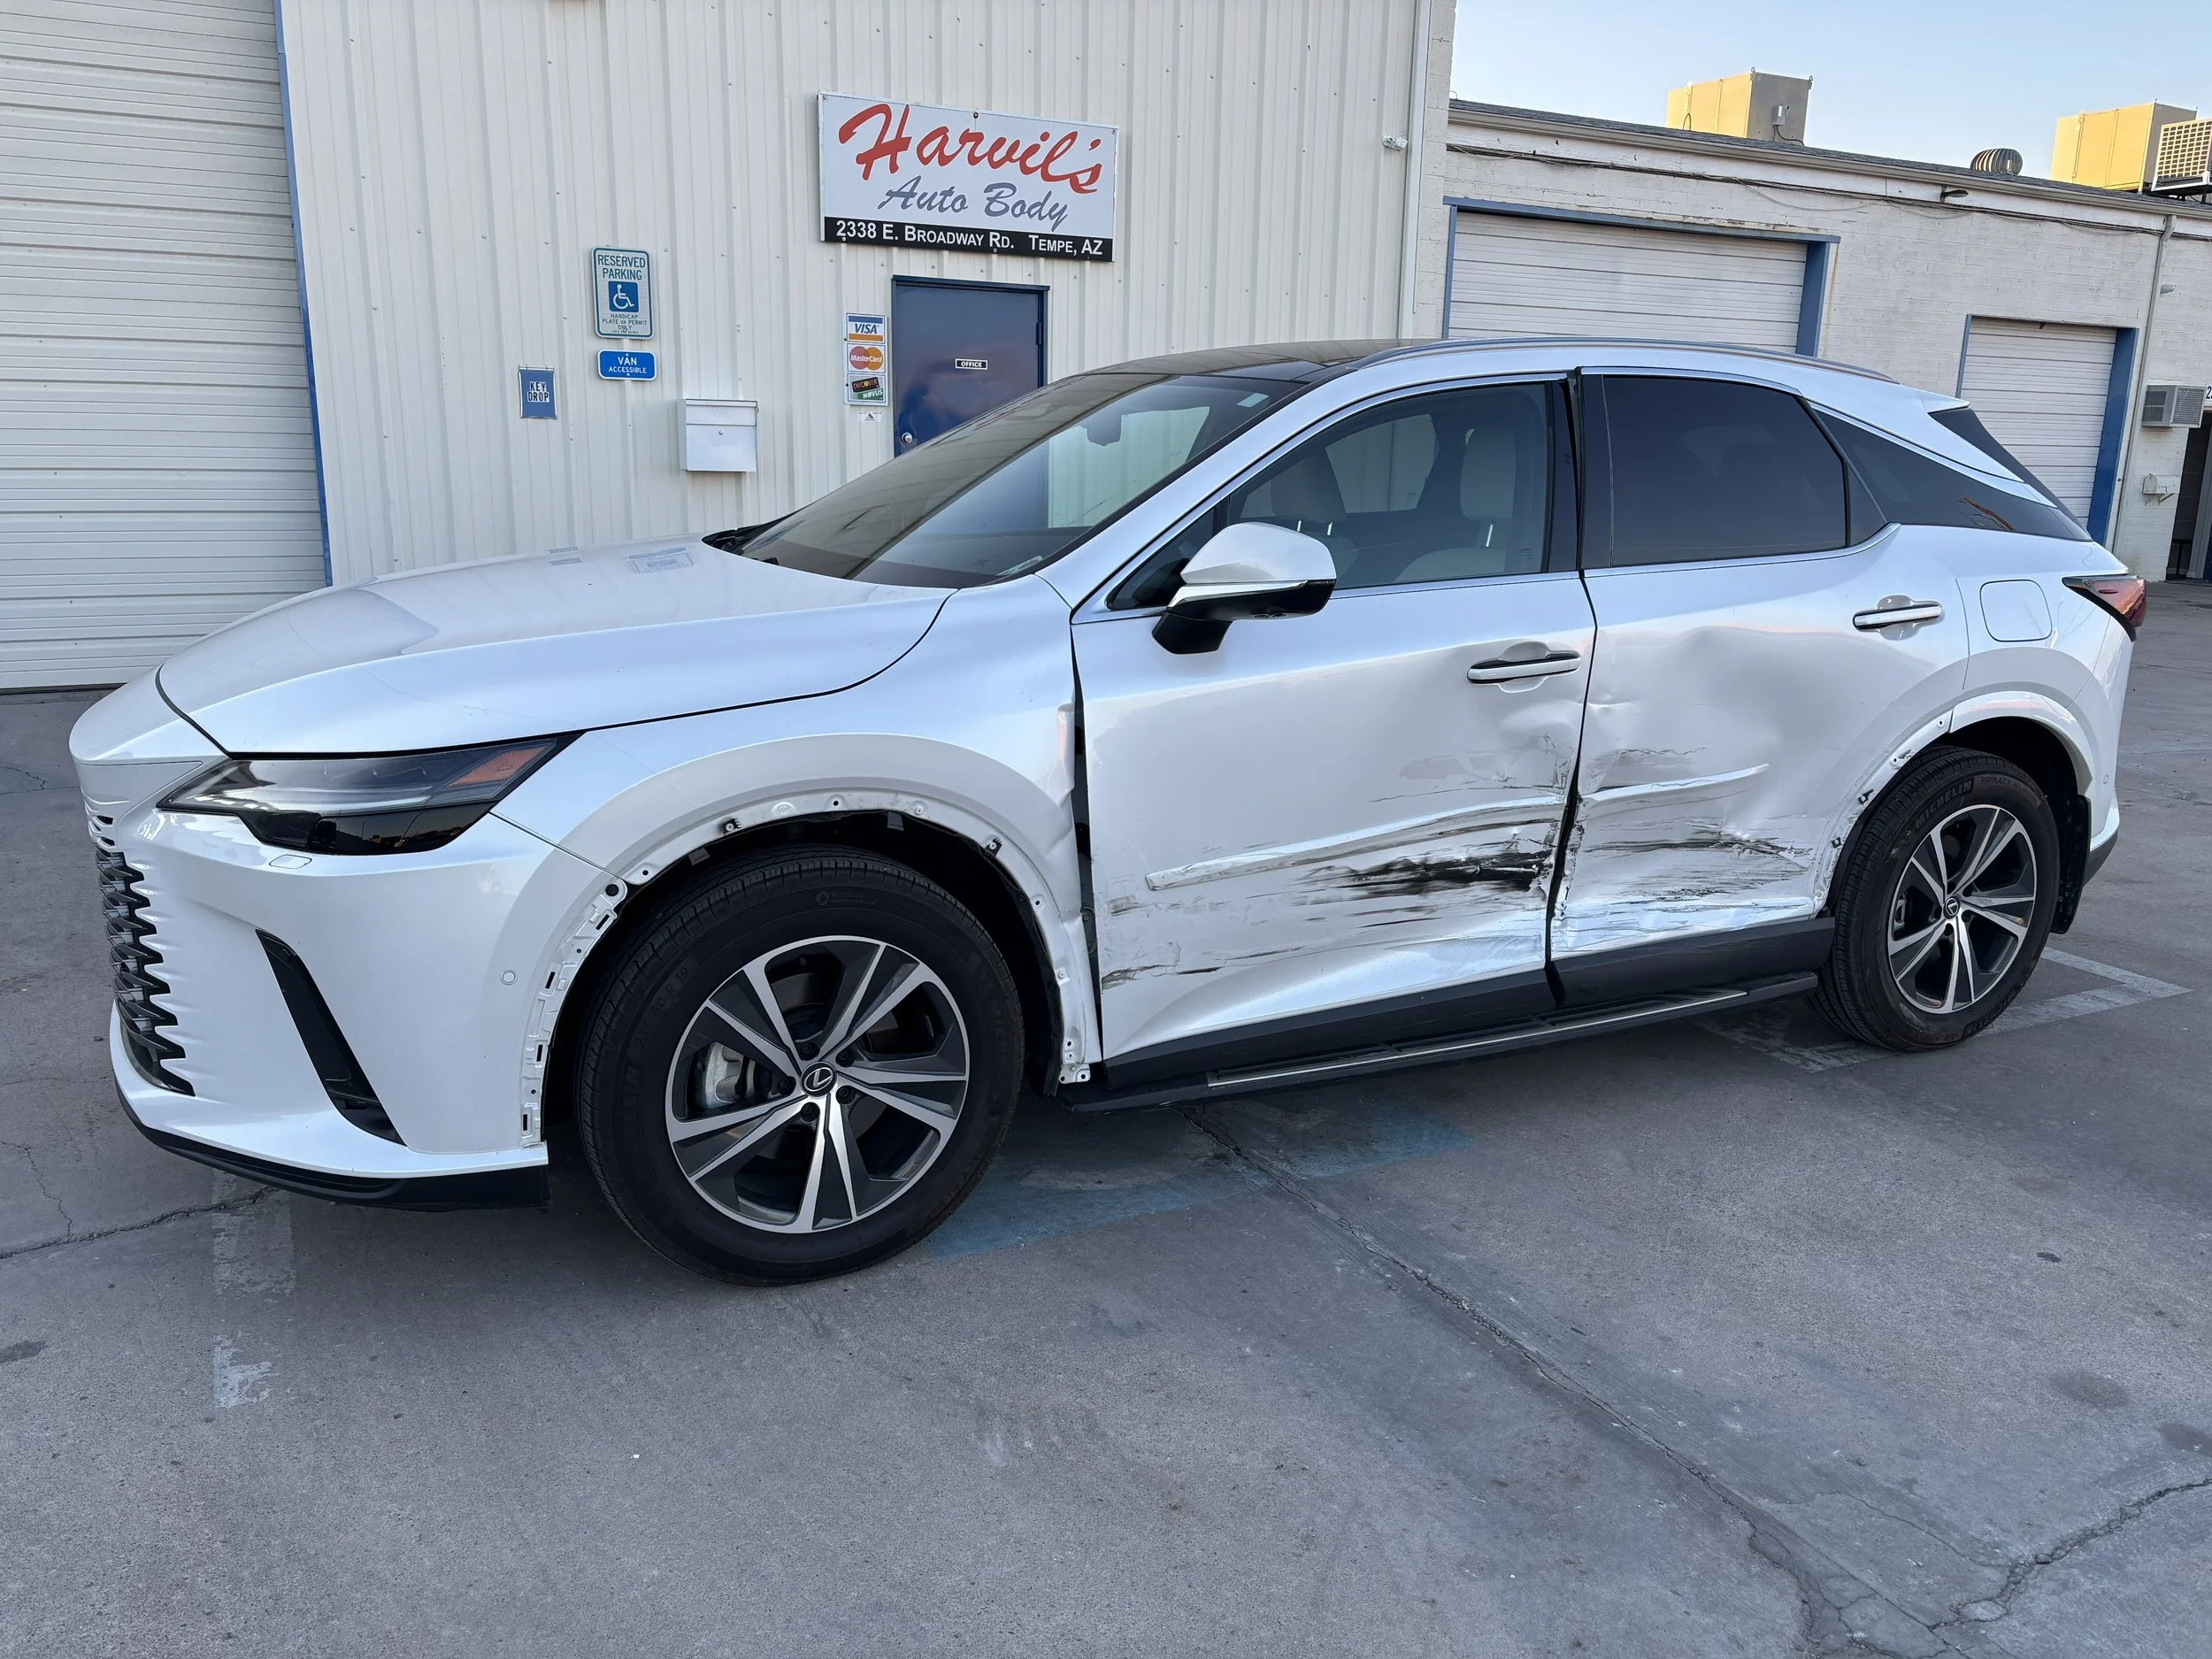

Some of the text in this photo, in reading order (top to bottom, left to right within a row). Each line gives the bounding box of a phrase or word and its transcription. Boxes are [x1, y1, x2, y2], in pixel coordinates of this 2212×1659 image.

[838, 103, 1102, 195] Harvil's
[877, 175, 1069, 233] Auto Body
[836, 220, 877, 239] 2338
[883, 224, 899, 241] E.
[1081, 239, 1103, 256] AZ
[597, 254, 646, 268] RESERVED
[603, 267, 642, 280] PARKING
[854, 323, 878, 334] VISA
[618, 357, 637, 366] VAN
[850, 354, 882, 363] MasterCard
[608, 365, 647, 374] ACCESSIBLE
[530, 381, 546, 392] KEY
[2206, 386, 2212, 399] 2
[527, 391, 549, 402] DROP
[863, 388, 883, 399] NOVUS
[1914, 776, 2012, 830] MICHELIN PRIMACY
